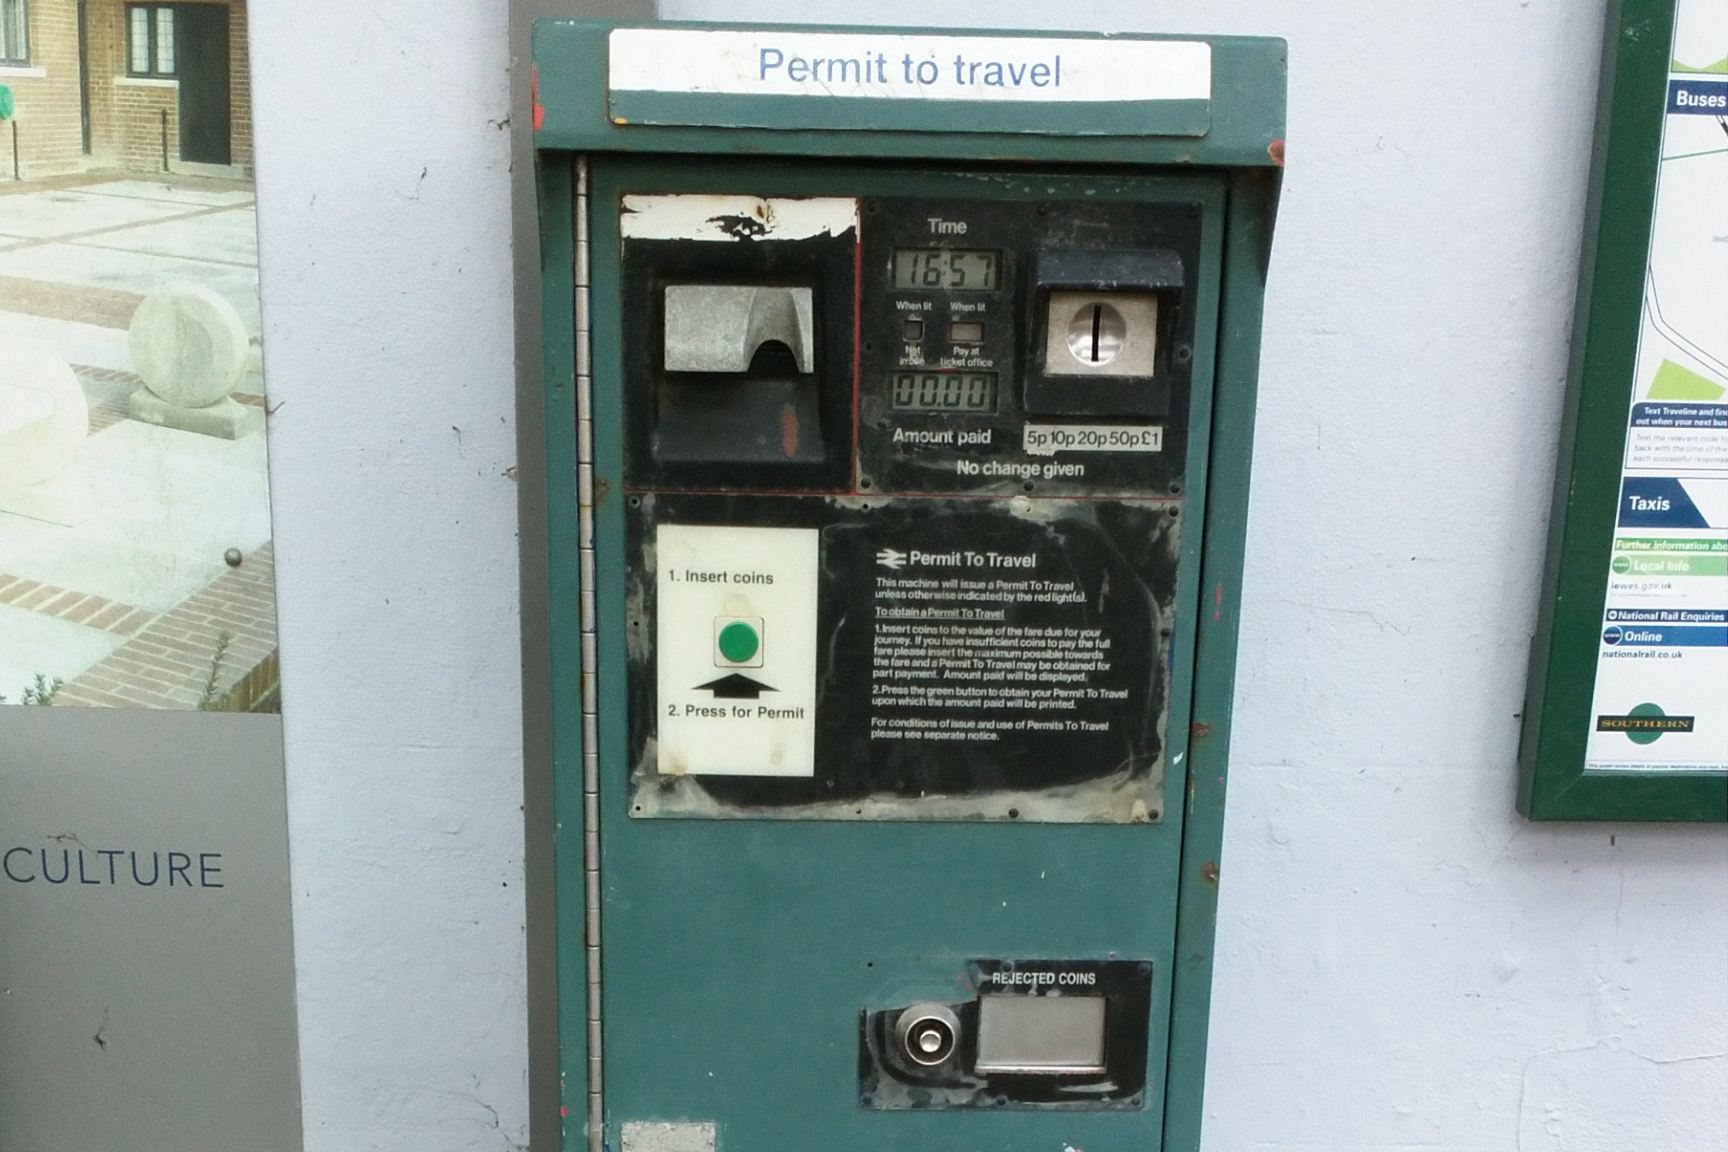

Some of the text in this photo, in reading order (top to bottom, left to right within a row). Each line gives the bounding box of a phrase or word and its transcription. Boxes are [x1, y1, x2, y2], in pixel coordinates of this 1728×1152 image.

[760, 48, 1061, 87] Permit to travel
[1676, 90, 1727, 108] Buses
[927, 218, 968, 234] Time
[911, 254, 992, 287] 16:57
[896, 301, 932, 311] When lit
[950, 302, 986, 312] When lit
[905, 345, 920, 355] Nt
[953, 346, 980, 357] Pay at
[940, 357, 994, 368] ticket office
[1644, 406, 1661, 415] Text
[1662, 407, 1698, 416] Traveline
[1698, 408, 1714, 416] and
[1651, 417, 1673, 425] when
[1675, 419, 1693, 427] your
[1713, 418, 1728, 427] bus
[893, 428, 992, 446] Amount paid
[1027, 431, 1159, 448] 5p 10p 20p 50p £1
[957, 460, 1085, 479] No change given
[1629, 495, 1671, 511] Taxis
[1615, 540, 1652, 551] Further
[1653, 541, 1709, 551] information
[910, 550, 1036, 568] Permit To Travel
[1632, 560, 1665, 572] Local
[1667, 560, 1690, 572] Info
[668, 570, 774, 585] 1. Insert coins
[876, 577, 1074, 591] This machine will issue a Permit To Travel
[875, 589, 907, 599] unless
[907, 590, 957, 600] otherwise
[957, 591, 1003, 601] indicated
[1004, 592, 1015, 603] by
[1017, 592, 1033, 602] the
[1034, 593, 1051, 602] red
[875, 606, 1005, 619] To obtain a Permit To Travel
[1618, 611, 1725, 622] National Rail Enquiries
[912, 624, 939, 635] coins
[939, 625, 950, 635] to
[951, 625, 967, 635] the
[968, 626, 994, 636] value
[995, 626, 1006, 636] of
[1007, 626, 1023, 636] the
[1024, 626, 1043, 637] fare
[1044, 627, 1063, 637] due
[1064, 627, 1078, 637] for
[1080, 630, 1102, 639] your
[1624, 631, 1663, 642] Online
[874, 635, 1111, 650] journey. If you have insufficient coins to pay the full
[874, 646, 1104, 660] fare please insert the maximum possible towards
[1602, 650, 1683, 659] nationalrail.co.uk
[873, 657, 1111, 672] the fare and a Permit To Travel may be obtained for
[872, 669, 893, 679] part
[943, 669, 982, 680] Amount
[983, 671, 1005, 681] paid
[1006, 671, 1024, 681] will
[1024, 671, 1037, 681] be
[910, 686, 925, 696] the
[927, 687, 955, 697] green
[956, 686, 987, 697] button
[988, 687, 997, 697] to
[998, 687, 1030, 697] obtain
[1031, 689, 1052, 699] your
[1053, 688, 1085, 698] Permit
[1086, 688, 1098, 699] To
[1099, 689, 1129, 699] Travel
[871, 697, 896, 707] upon
[898, 696, 927, 706] which
[928, 697, 943, 707] the
[945, 698, 981, 707] amount
[983, 699, 1005, 709] paid
[1006, 699, 1024, 708] will
[1024, 699, 1037, 709] be
[668, 704, 805, 720] 2. Press for Permit
[871, 717, 1109, 731] For conditions of issue and use of Permits To Travel
[1600, 720, 1689, 728] SOUTHERN
[871, 730, 903, 740] please
[904, 731, 922, 739] see
[923, 731, 966, 741] separate
[3, 847, 224, 888] CULTURE
[992, 972, 1096, 985] REJECTED COINS
